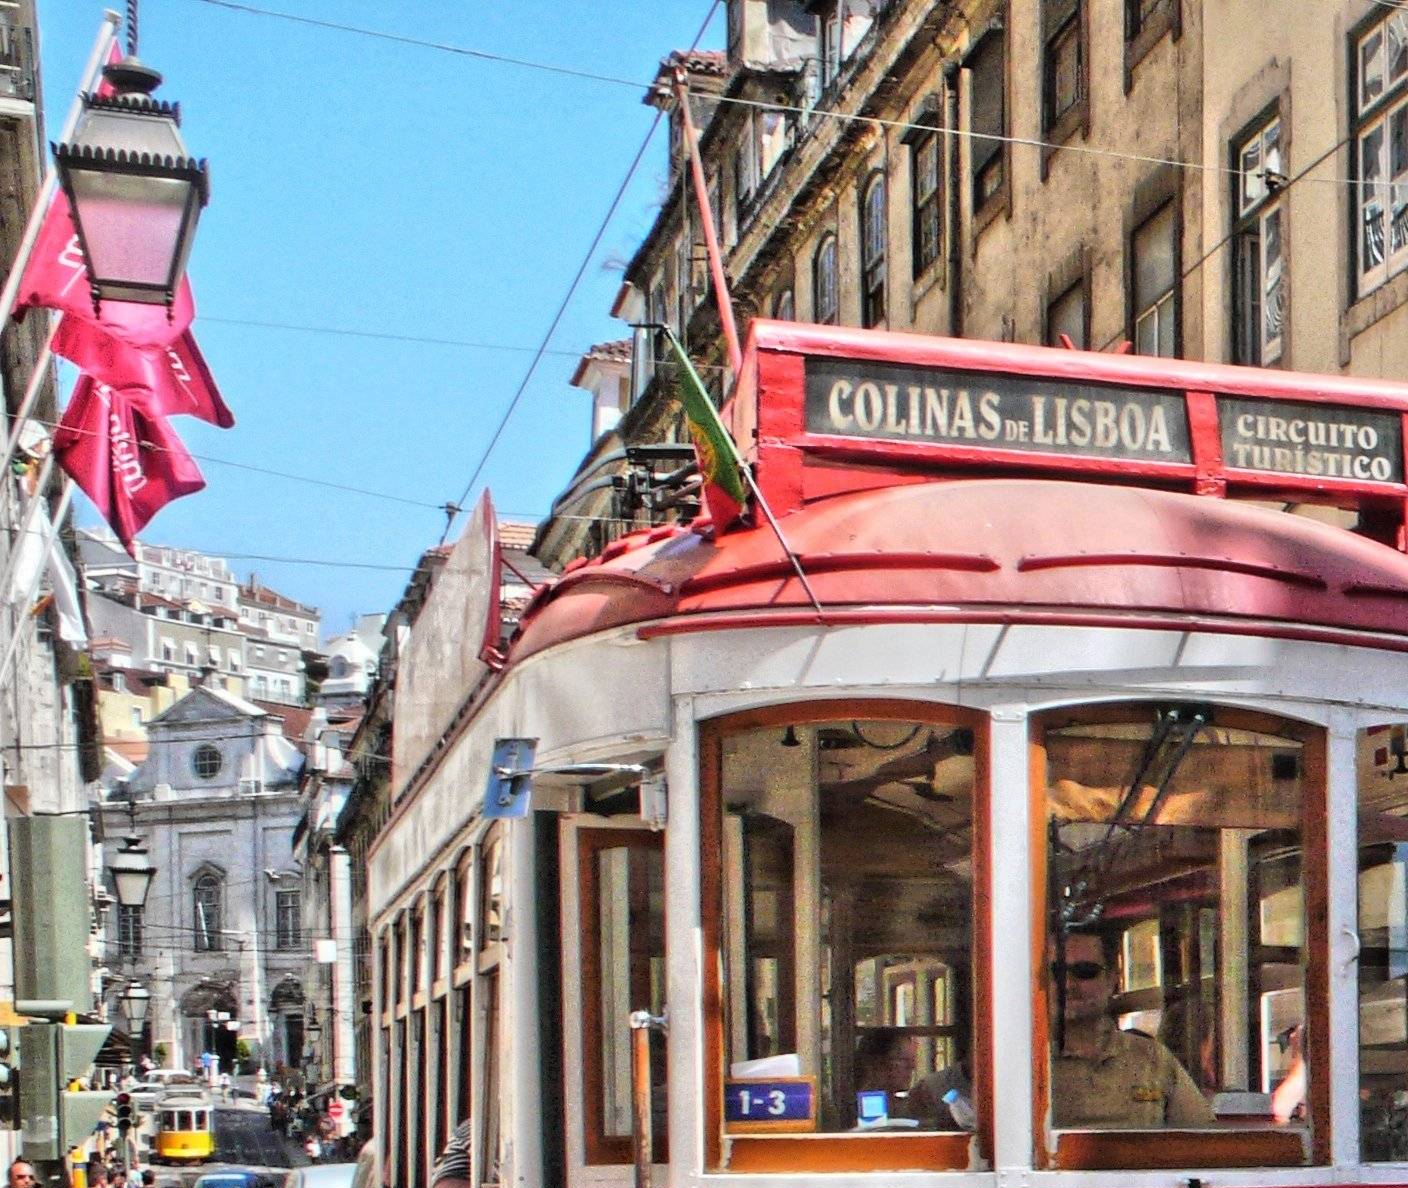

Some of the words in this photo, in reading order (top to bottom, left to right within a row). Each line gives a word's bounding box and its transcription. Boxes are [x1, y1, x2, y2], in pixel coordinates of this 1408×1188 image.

[828, 379, 1002, 442] COLINAS
[1005, 417, 1030, 443] DE
[1032, 395, 1173, 453] LISBOA
[1236, 413, 1379, 450] CIRCUITO
[1233, 443, 1392, 481] TURÍSTICO
[738, 1081, 788, 1117] 1-3
